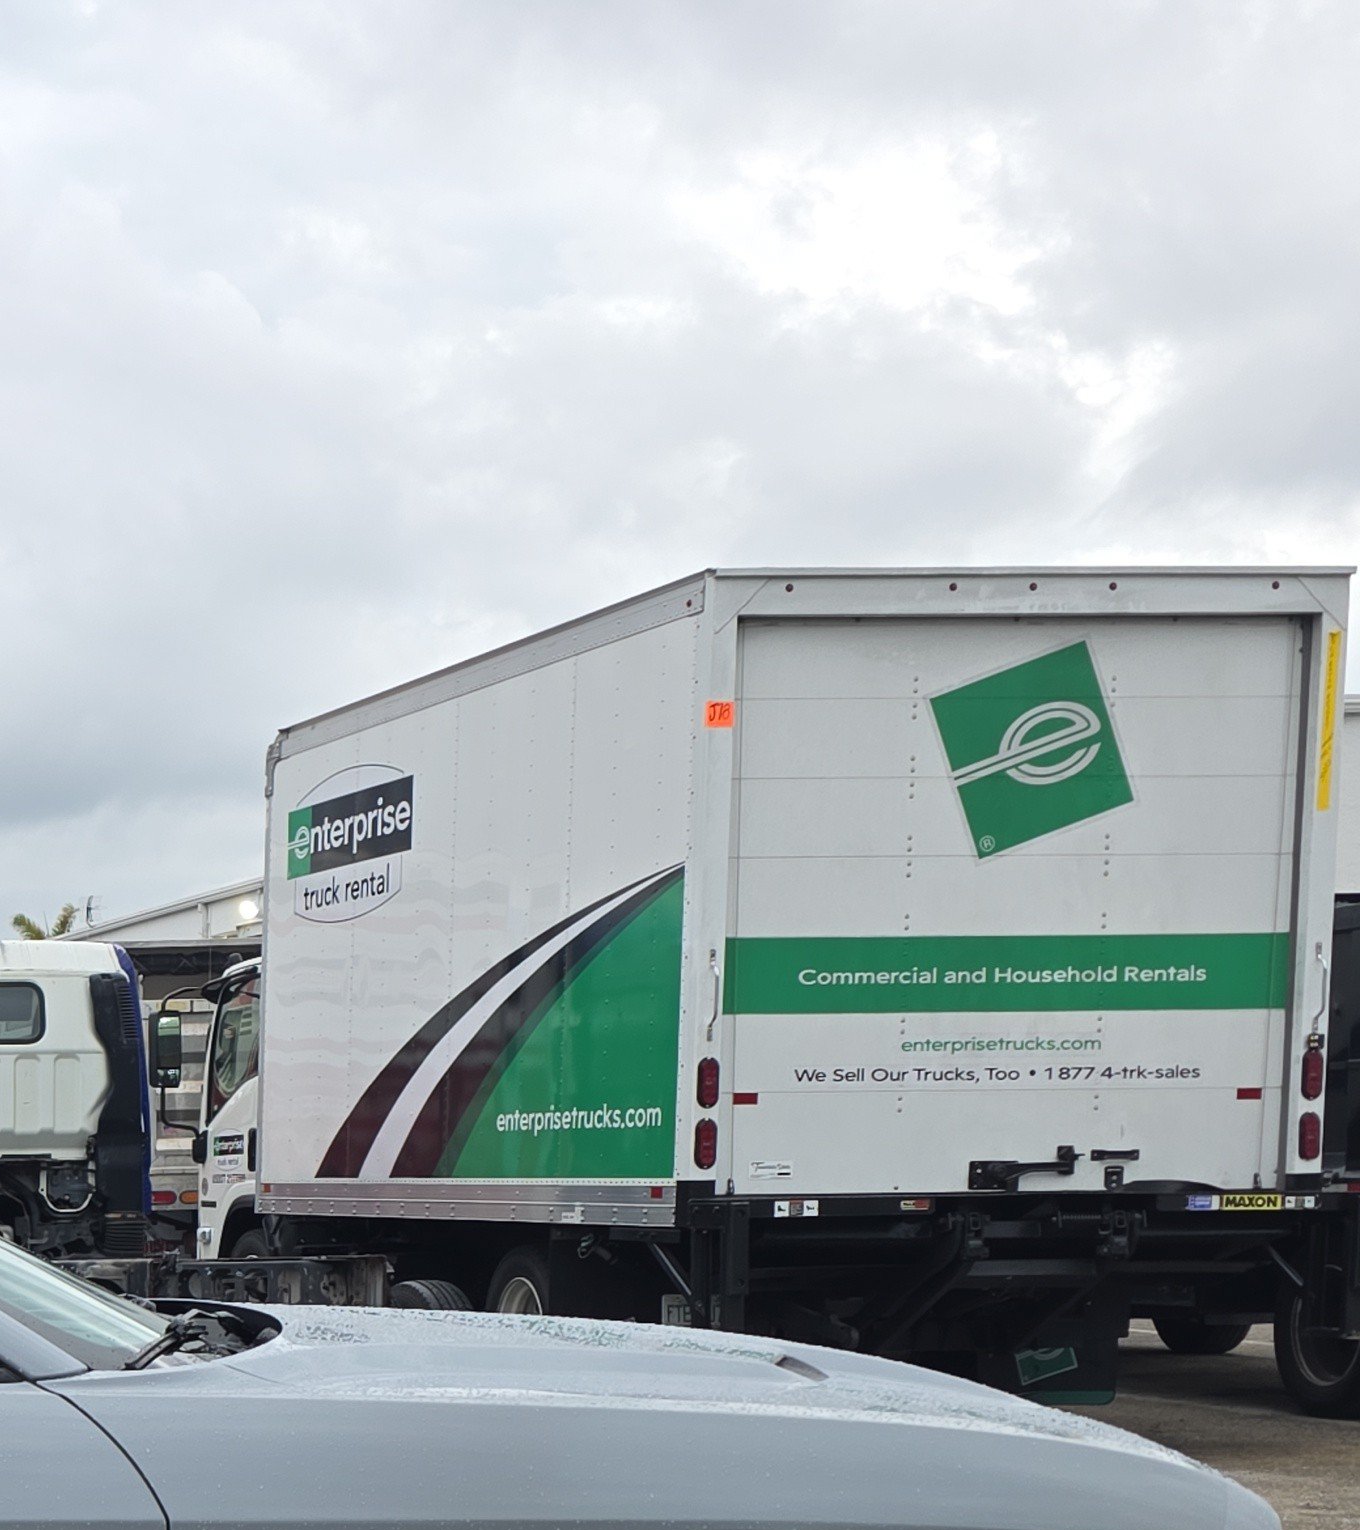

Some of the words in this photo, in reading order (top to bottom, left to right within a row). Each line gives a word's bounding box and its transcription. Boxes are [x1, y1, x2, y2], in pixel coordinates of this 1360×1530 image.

[288, 797, 412, 860] enterprise
[303, 875, 340, 911] truck
[345, 862, 390, 902] rental
[798, 967, 938, 985] Commercial
[943, 967, 987, 984] and
[993, 965, 1118, 984] Household
[1124, 964, 1207, 982] Rentals
[900, 1036, 1102, 1055] enterprisetrucks.com
[794, 1068, 827, 1083] We
[832, 1068, 865, 1083] Sell
[871, 1068, 908, 1083] Our
[912, 1067, 980, 1084] Trucks,
[985, 1067, 1020, 1081] Too
[1100, 1065, 1201, 1080] 4-trk-sales
[496, 1103, 662, 1137] enterprisetrucks.com
[1224, 1195, 1278, 1208] MAXON
